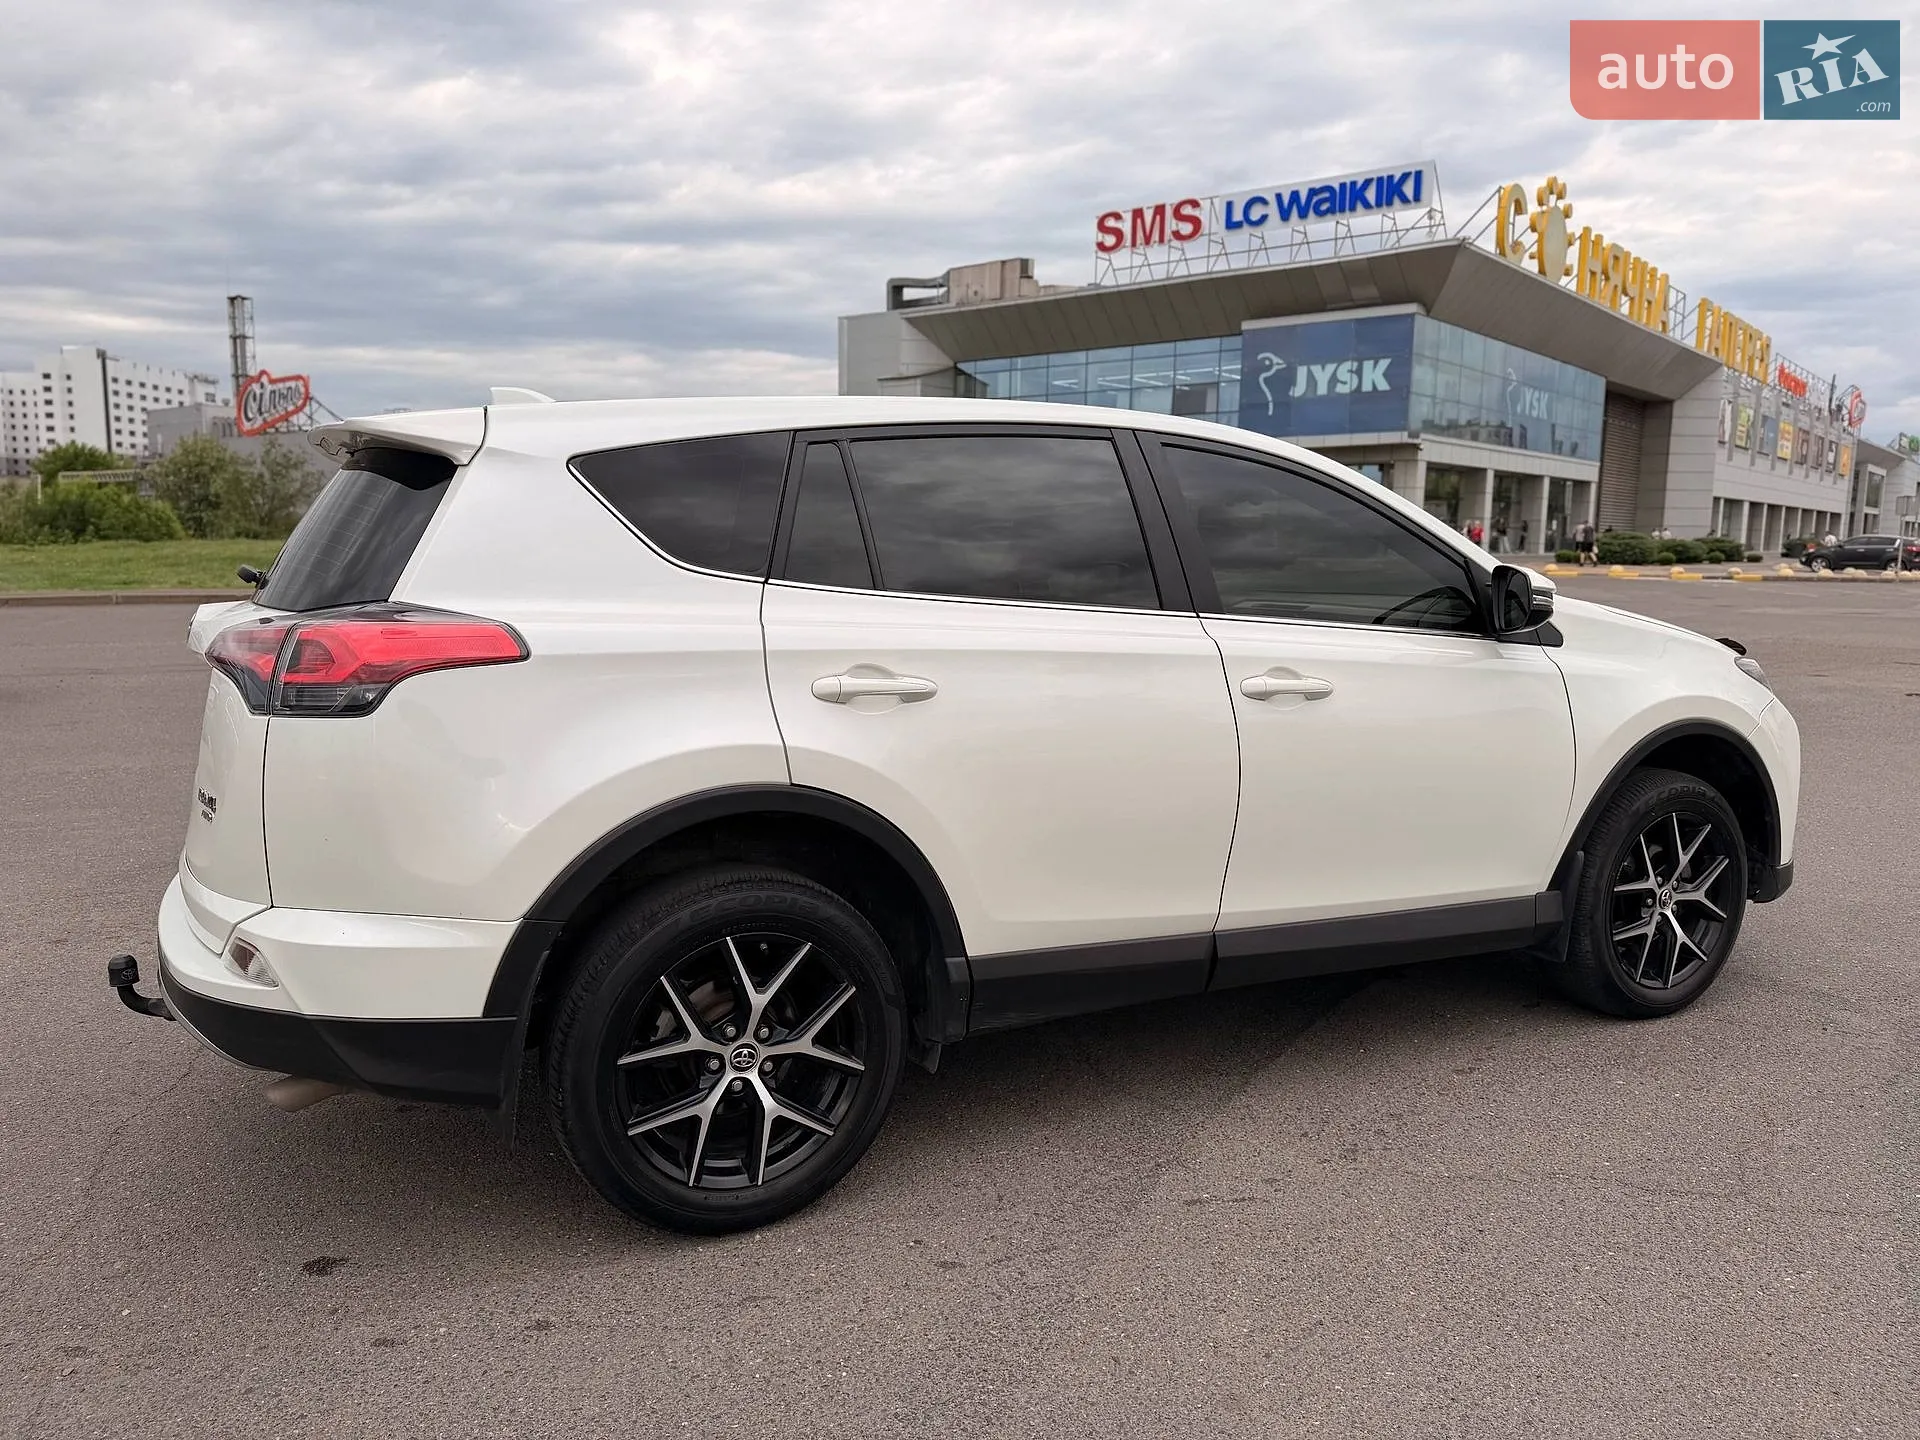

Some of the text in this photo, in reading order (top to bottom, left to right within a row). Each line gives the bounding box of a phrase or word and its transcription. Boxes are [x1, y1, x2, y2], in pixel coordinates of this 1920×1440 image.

[1095, 197, 1204, 254] SMS
[1224, 195, 1270, 231] LC
[1289, 357, 1393, 399] JYSK
[243, 381, 302, 424] Сільпо
[1516, 387, 1549, 420] JYSK
